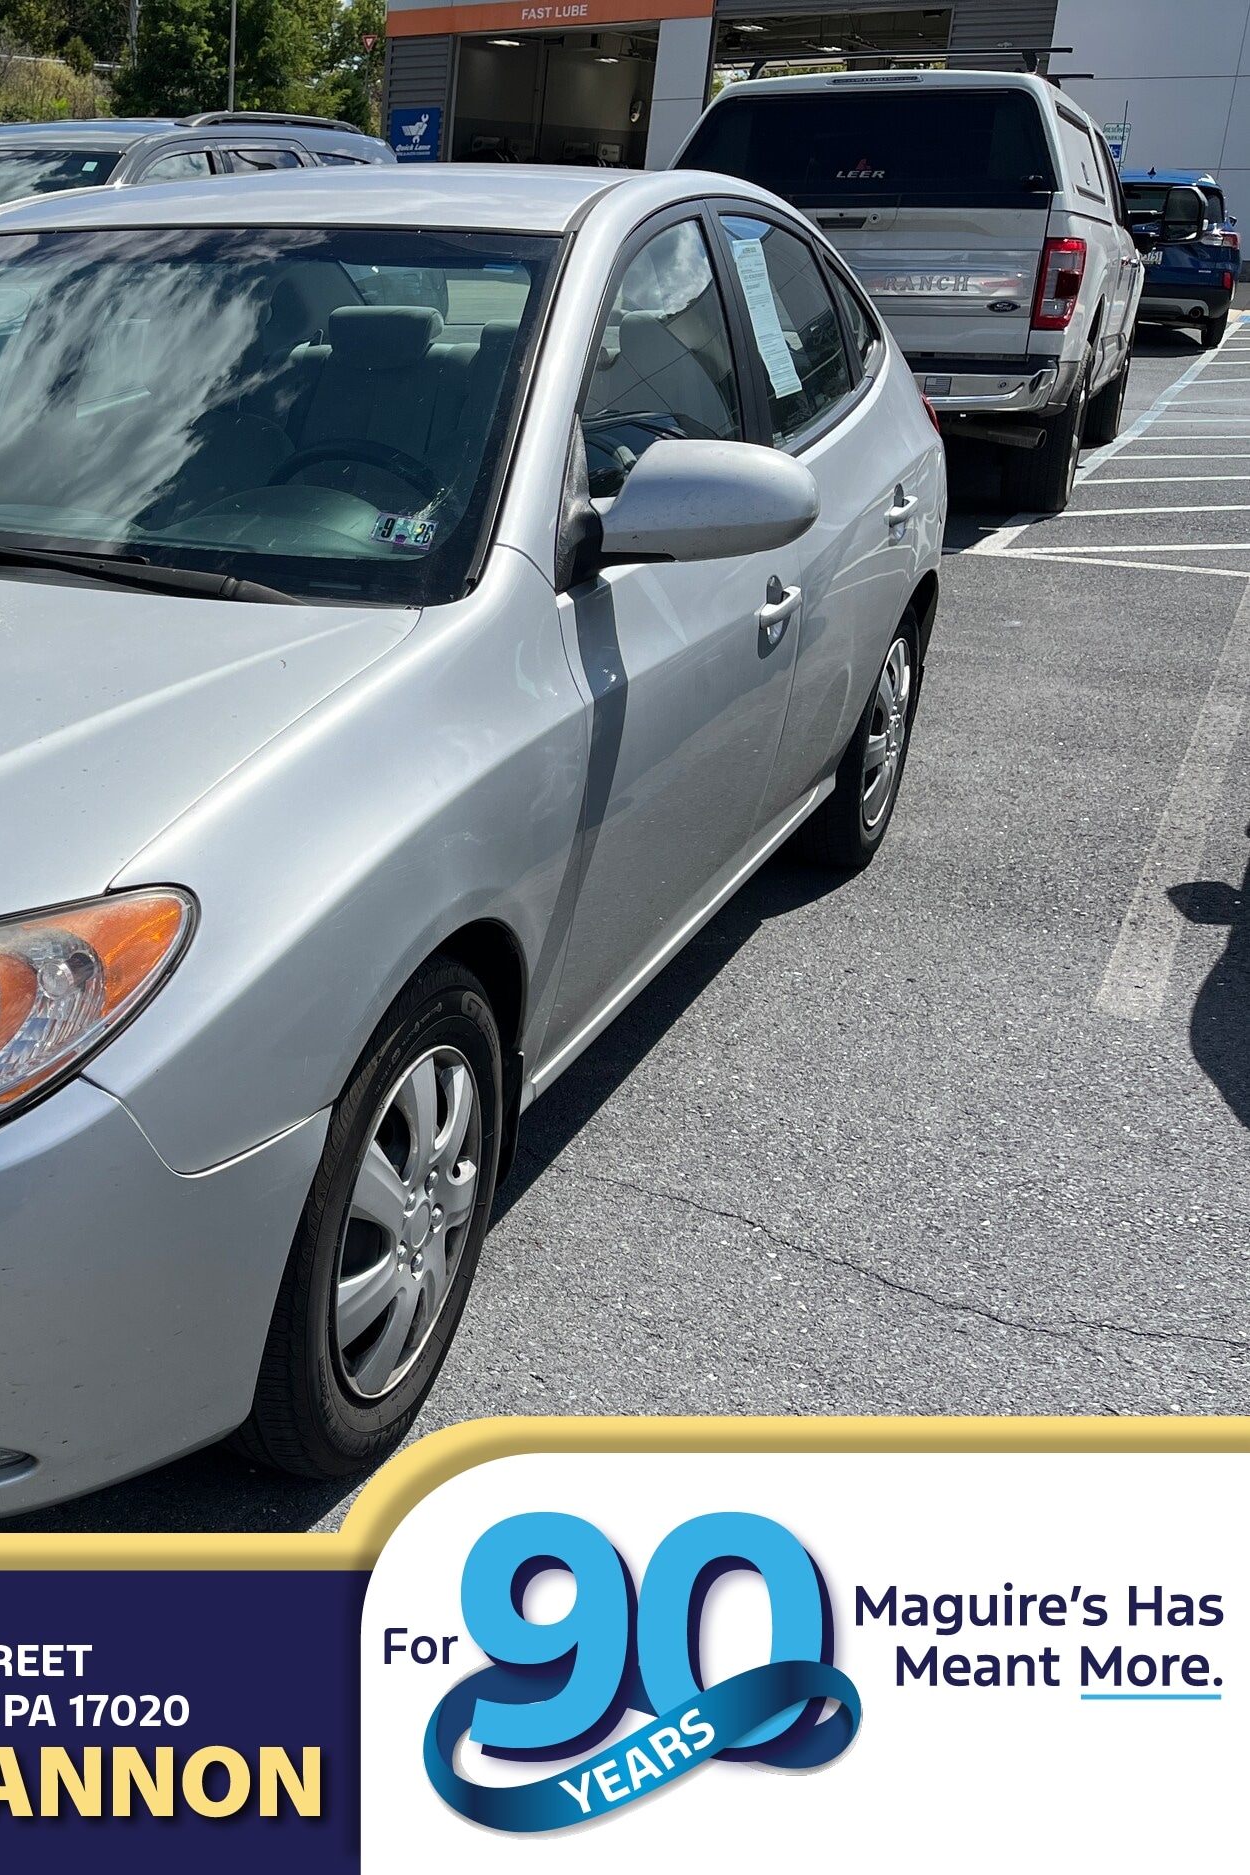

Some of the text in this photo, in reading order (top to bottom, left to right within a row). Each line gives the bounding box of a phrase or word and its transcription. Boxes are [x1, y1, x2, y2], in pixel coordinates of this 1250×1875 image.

[521, 4, 588, 20] FAST LUBE
[836, 170, 885, 179] LEER
[883, 275, 970, 292] RANCH
[381, 518, 396, 538] 9
